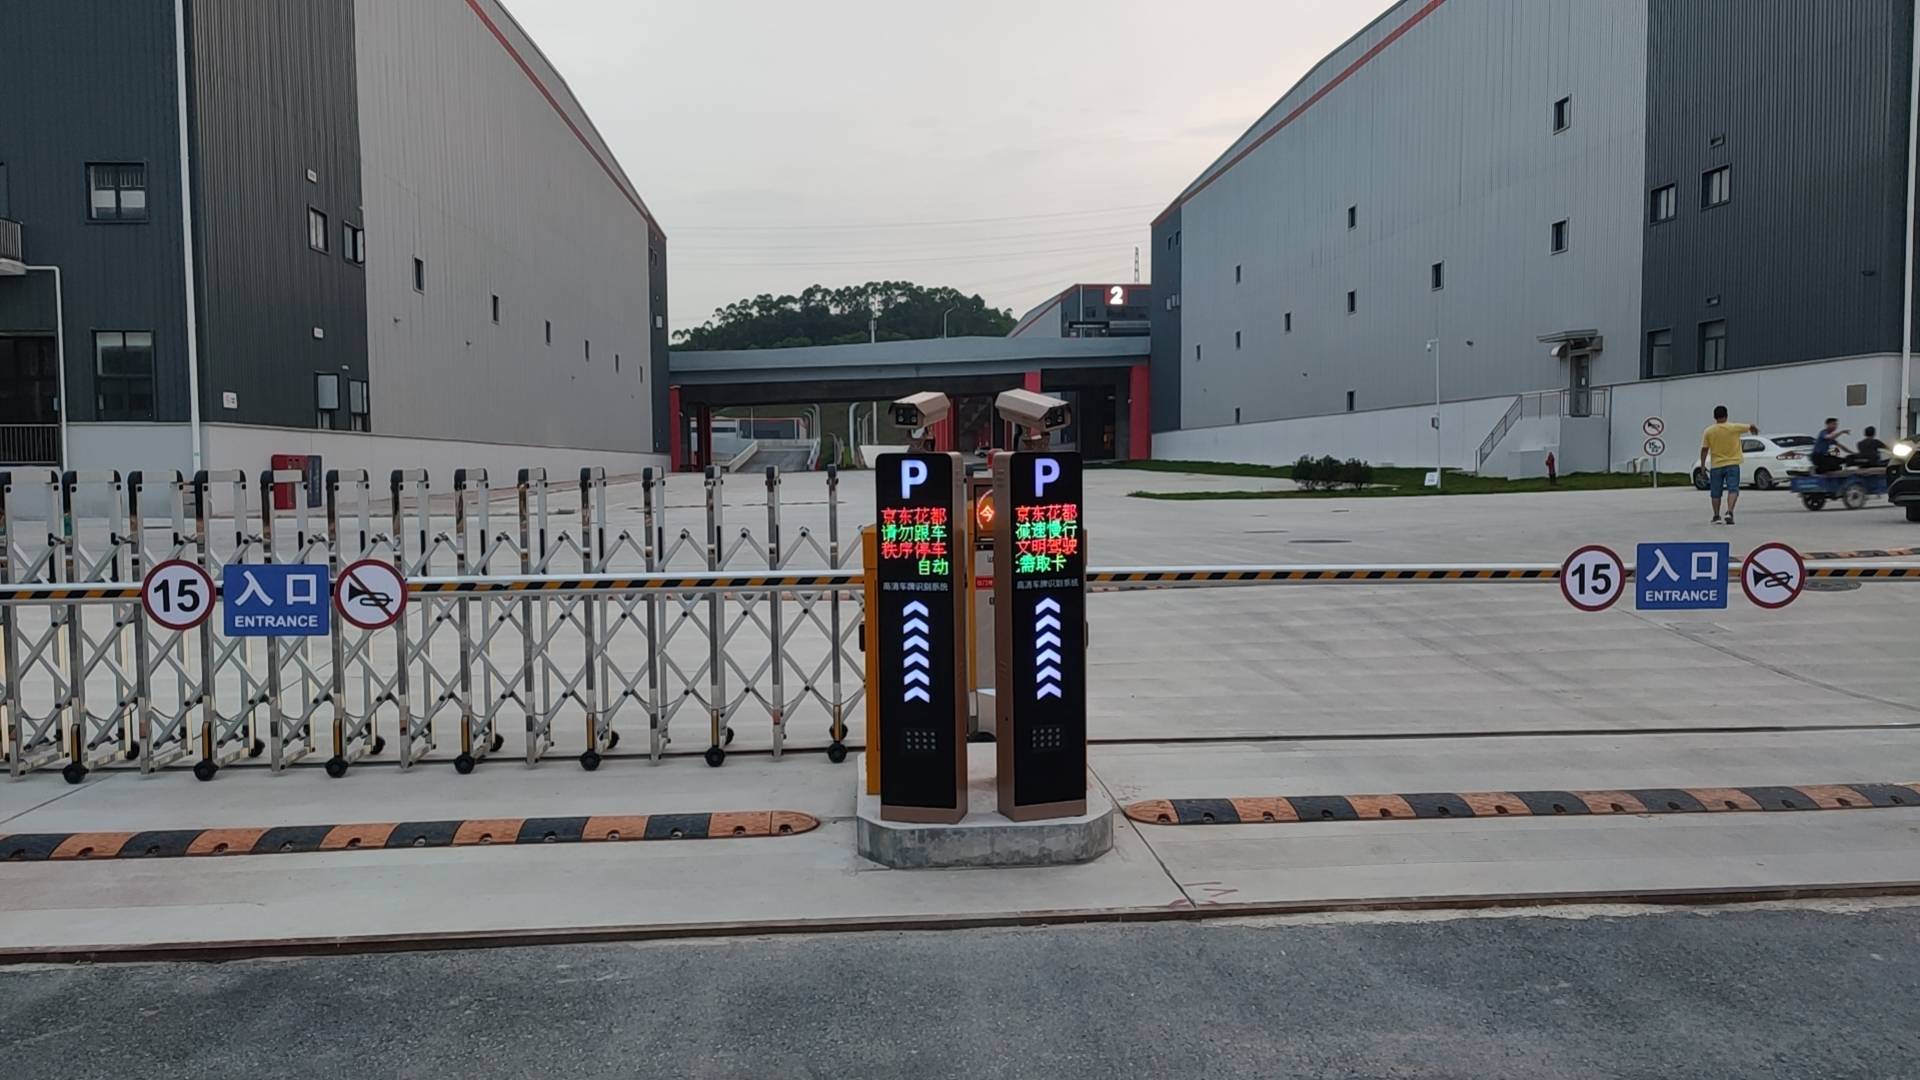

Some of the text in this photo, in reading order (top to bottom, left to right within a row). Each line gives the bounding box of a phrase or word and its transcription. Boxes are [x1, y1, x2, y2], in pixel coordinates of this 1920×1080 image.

[1110, 285, 1123, 305] 2
[901, 459, 928, 499] P
[1035, 458, 1060, 498] P
[881, 506, 947, 524] 京东花都
[1015, 504, 1078, 521] 京东花都
[881, 524, 947, 542] 请勿跟车
[1015, 519, 1078, 539] 减速慢行
[881, 541, 947, 559] 秩序停车
[1015, 538, 1078, 557] 文明驾驶
[918, 558, 949, 575] 自动
[1015, 554, 1067, 573] 需取卡
[1646, 548, 1719, 582] 入口
[234, 570, 317, 607] 入口
[1571, 563, 1611, 595] 15
[153, 579, 200, 612] 15
[1645, 590, 1718, 602] ENTRANCE
[234, 615, 318, 628] ENTRANCE
